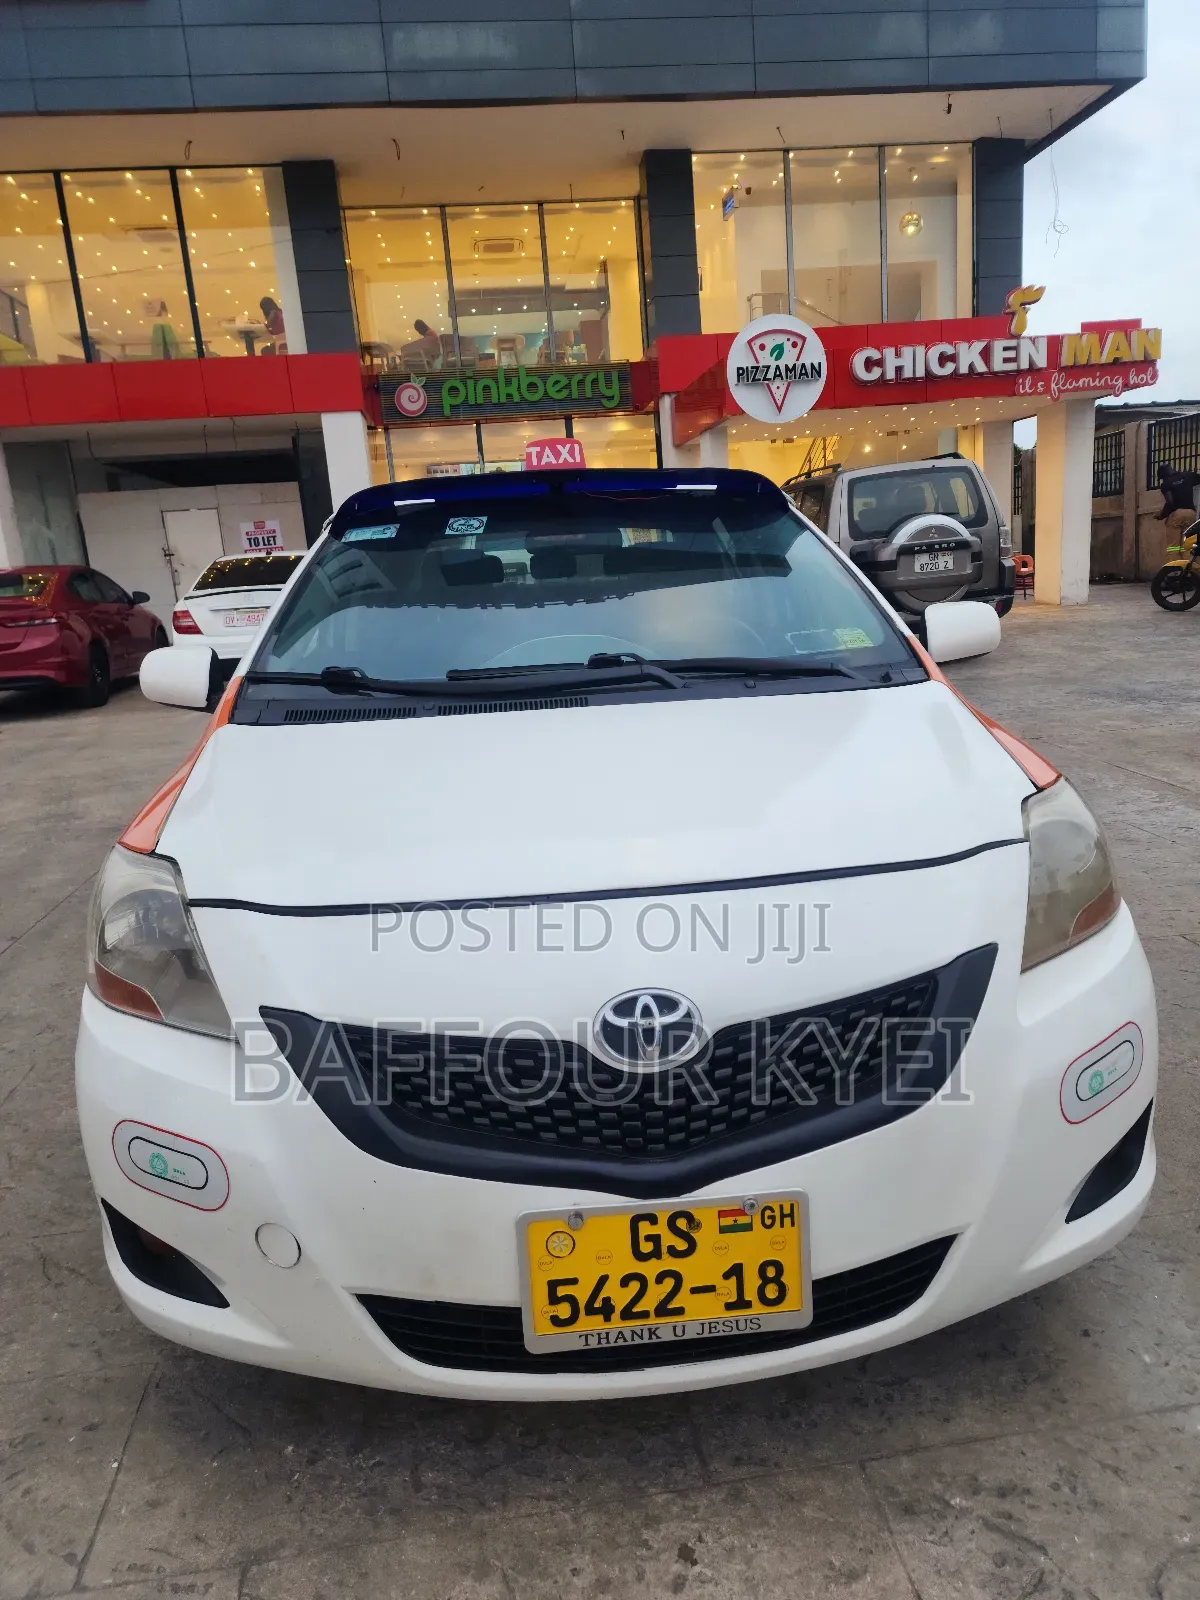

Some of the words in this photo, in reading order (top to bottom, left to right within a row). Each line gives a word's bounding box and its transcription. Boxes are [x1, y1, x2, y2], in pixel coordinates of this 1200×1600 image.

[851, 336, 1047, 385] CHICKEN
[1061, 328, 1162, 367] MAN
[736, 361, 822, 385] PIZZAMAN
[1051, 371, 1125, 399] flaming
[441, 366, 620, 417] pinkberry
[526, 443, 581, 466] TAXI
[246, 537, 260, 548] TO
[261, 535, 277, 547] LET
[920, 562, 939, 571] 8720
[944, 561, 949, 569] Z
[630, 1211, 698, 1262] GS
[760, 1203, 796, 1230] GH
[546, 1259, 788, 1328] 5422-18
[579, 1327, 662, 1347] THANK
[672, 1324, 686, 1338] U
[696, 1317, 762, 1336] JESUS
